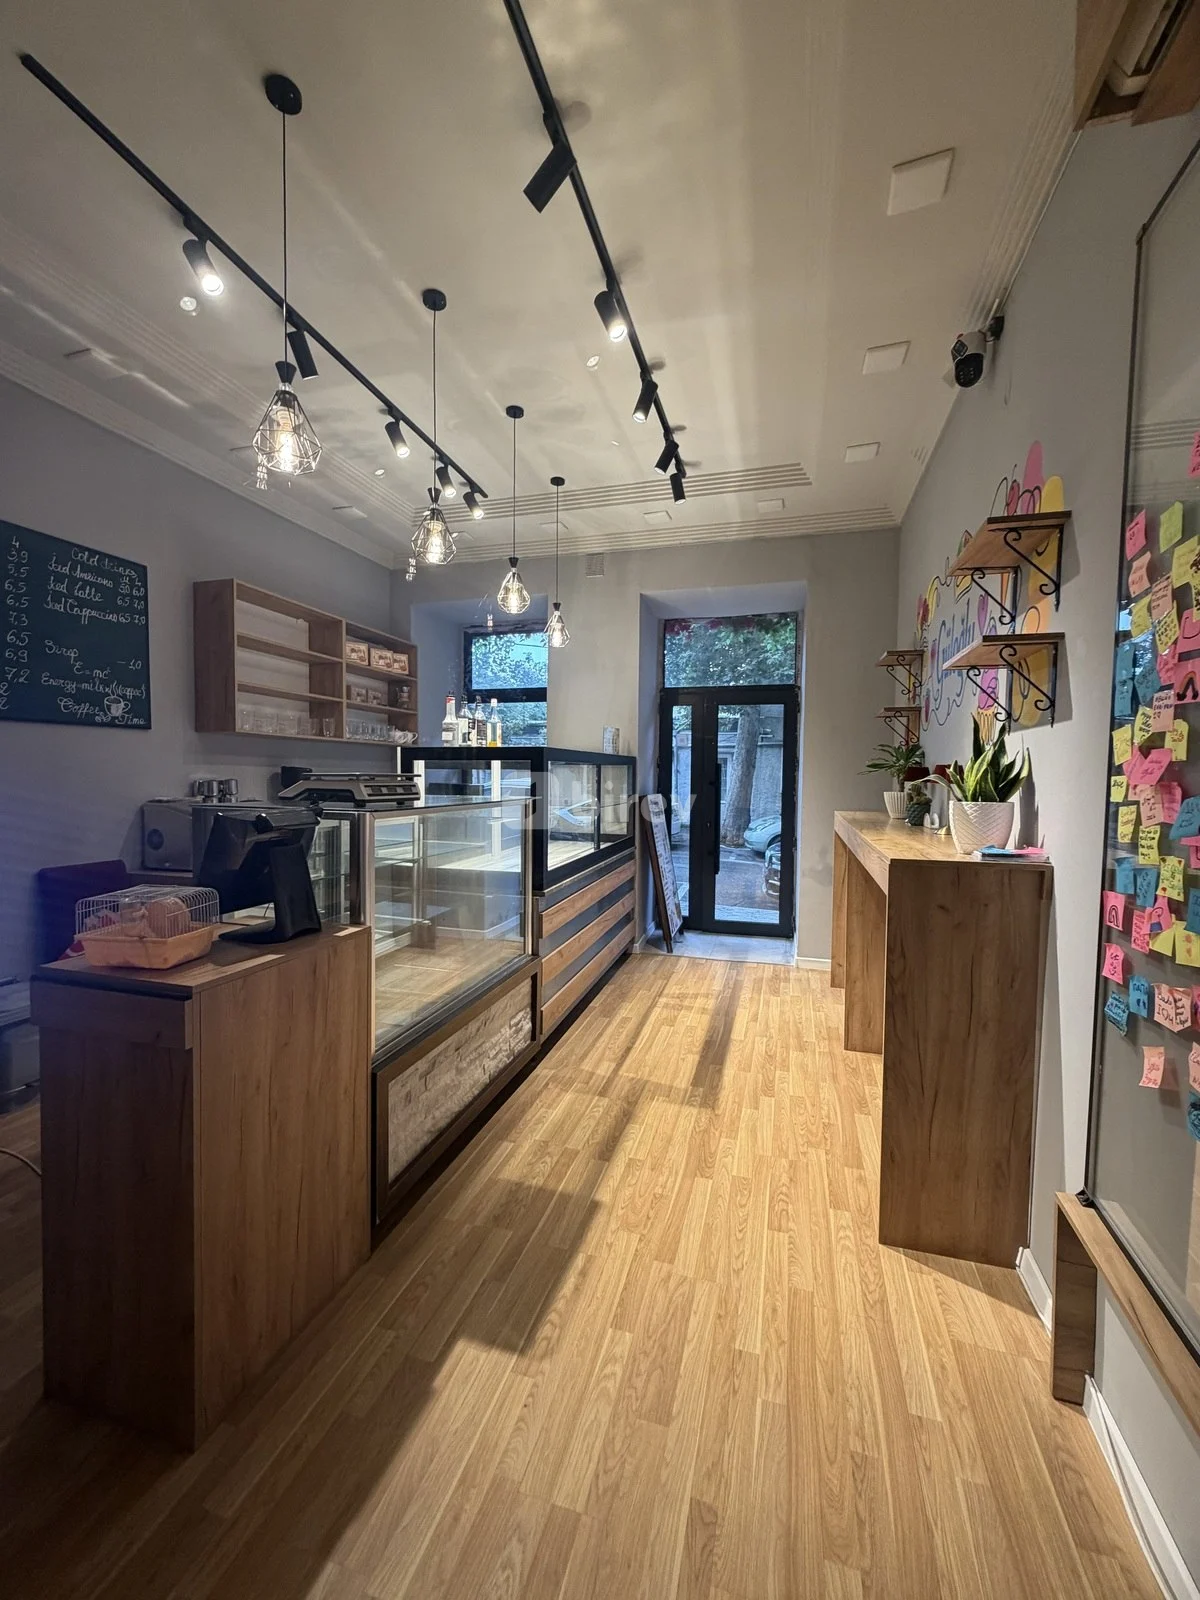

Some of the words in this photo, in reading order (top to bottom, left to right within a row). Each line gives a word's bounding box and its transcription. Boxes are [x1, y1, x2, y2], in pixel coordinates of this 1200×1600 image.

[12, 536, 20, 548] 4
[7, 548, 28, 563] 3,9
[71, 547, 100, 566] Cold
[7, 564, 29, 577] 5,5
[4, 579, 27, 593] 6,5
[73, 581, 104, 602] Latte
[6, 594, 30, 608] 6,5
[9, 611, 28, 626] 7,3
[6, 629, 31, 646] 6,5
[5, 648, 28, 662] 6,9
[44, 639, 79, 664] Sirop
[4, 666, 30, 683] 7,2
